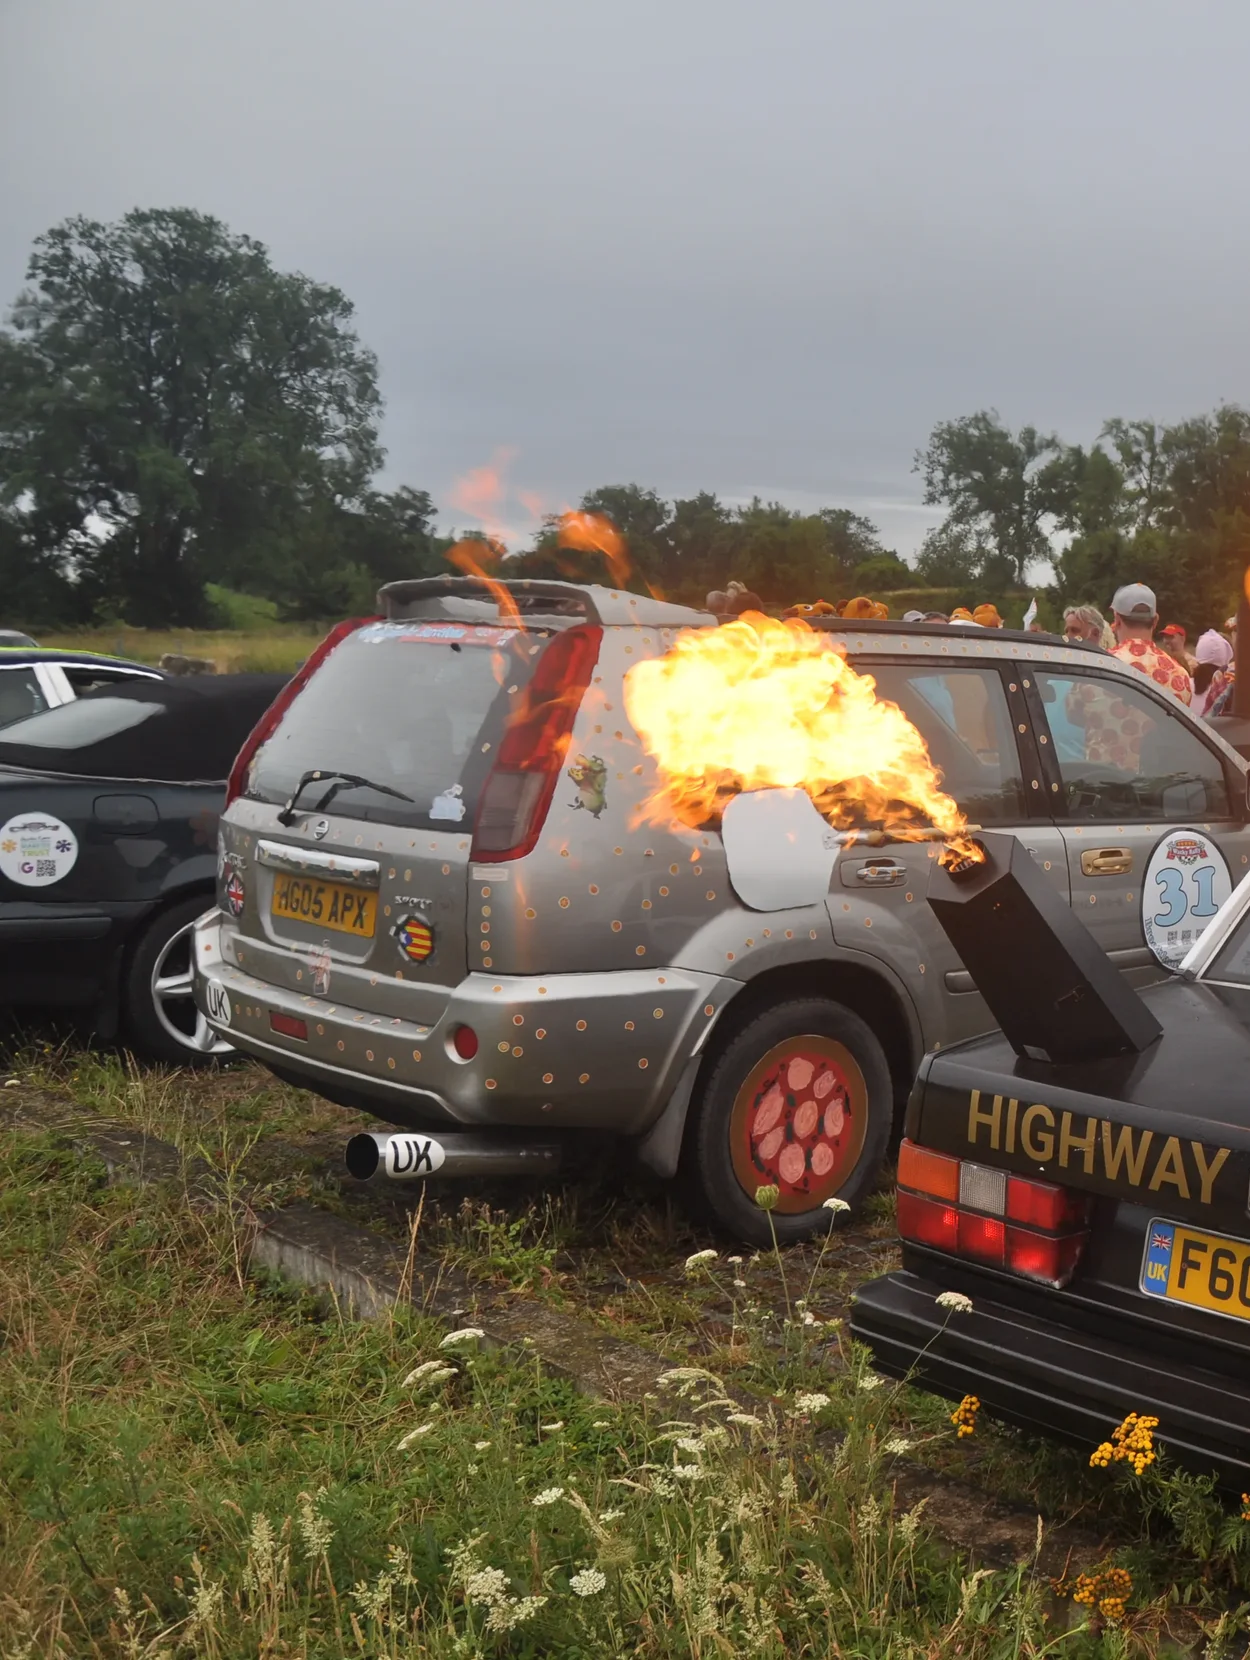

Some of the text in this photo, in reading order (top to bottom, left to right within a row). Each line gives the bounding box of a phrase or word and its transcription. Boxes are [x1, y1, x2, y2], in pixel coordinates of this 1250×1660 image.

[278, 881, 367, 930] HG05 APX
[1154, 865, 1219, 928] 31
[208, 990, 229, 1021] UK
[391, 1141, 433, 1173] UK
[968, 1089, 1231, 1205] HIGHWAY
[1148, 1261, 1168, 1282] UK
